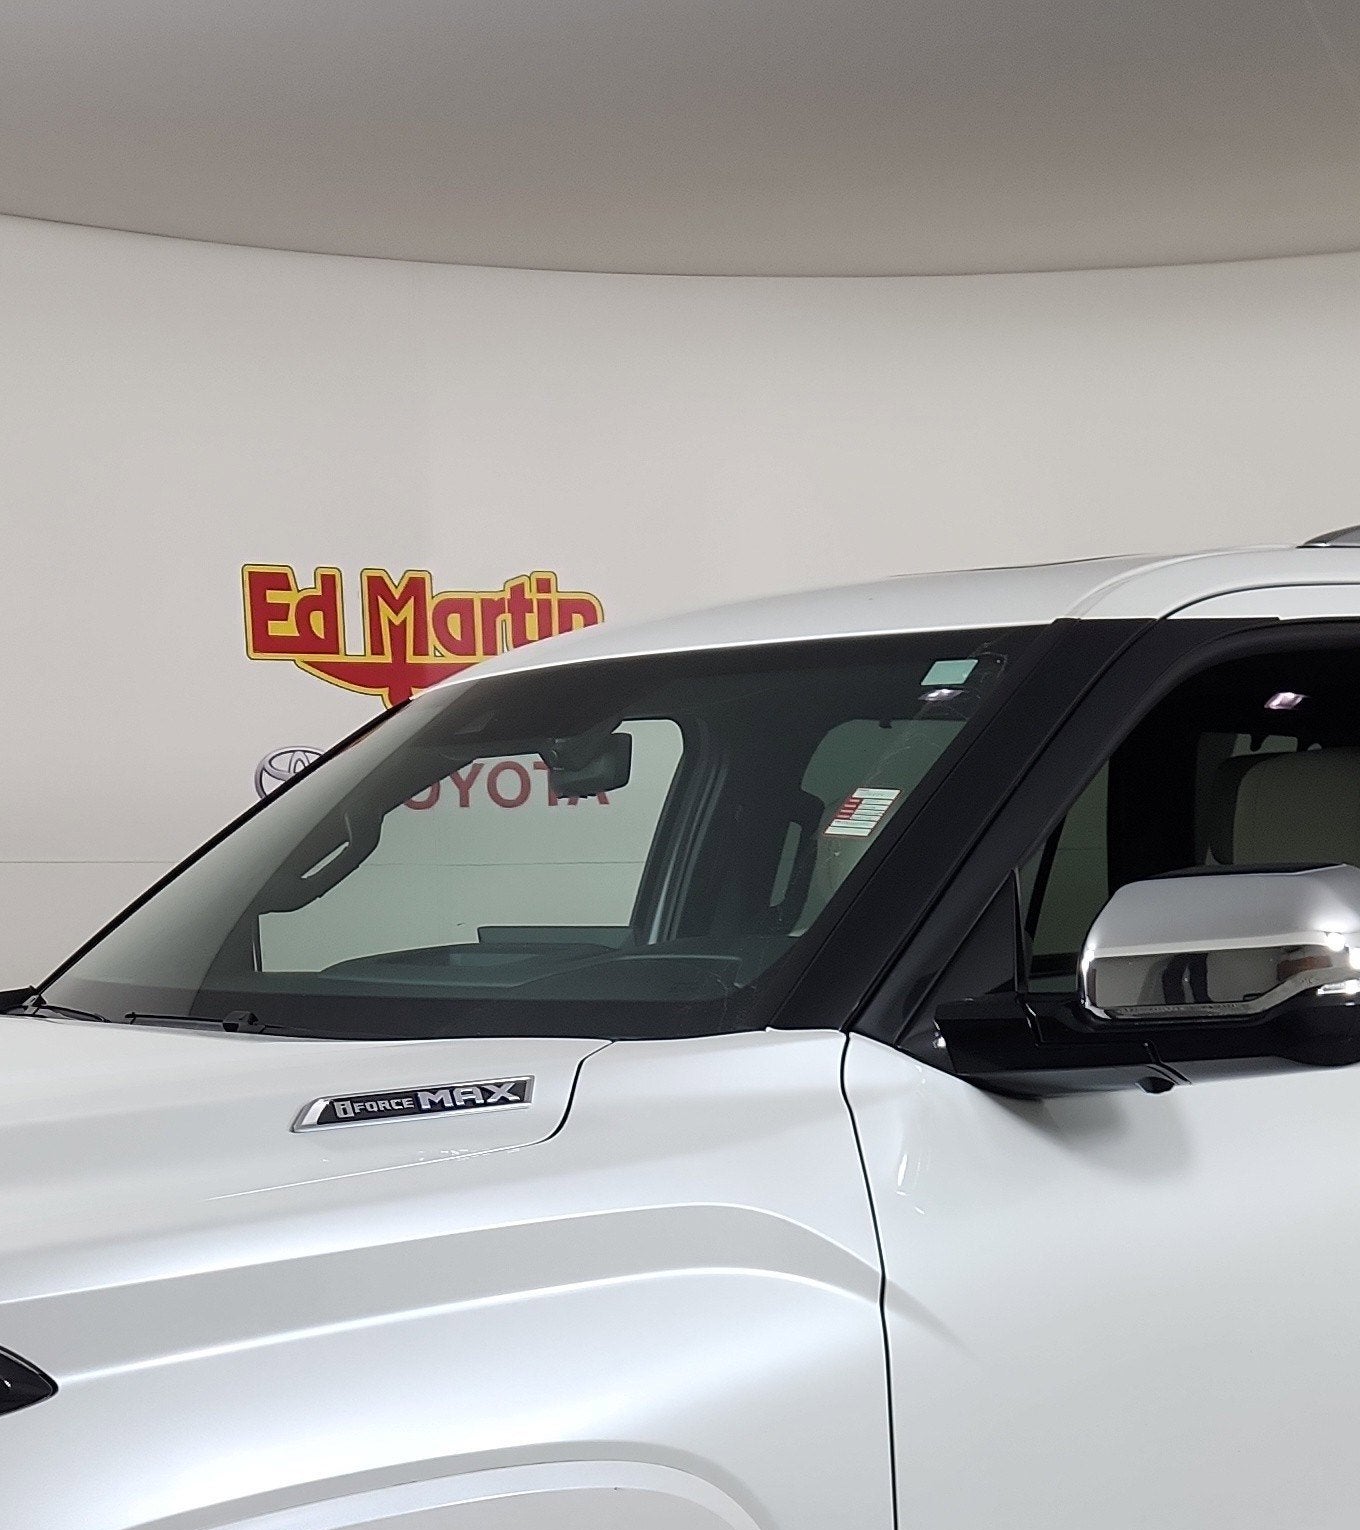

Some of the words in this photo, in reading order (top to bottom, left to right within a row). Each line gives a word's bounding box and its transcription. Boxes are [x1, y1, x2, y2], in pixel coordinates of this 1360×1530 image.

[245, 567, 341, 657] Ed
[364, 571, 601, 656] Martin
[417, 1082, 520, 1110] MAX
